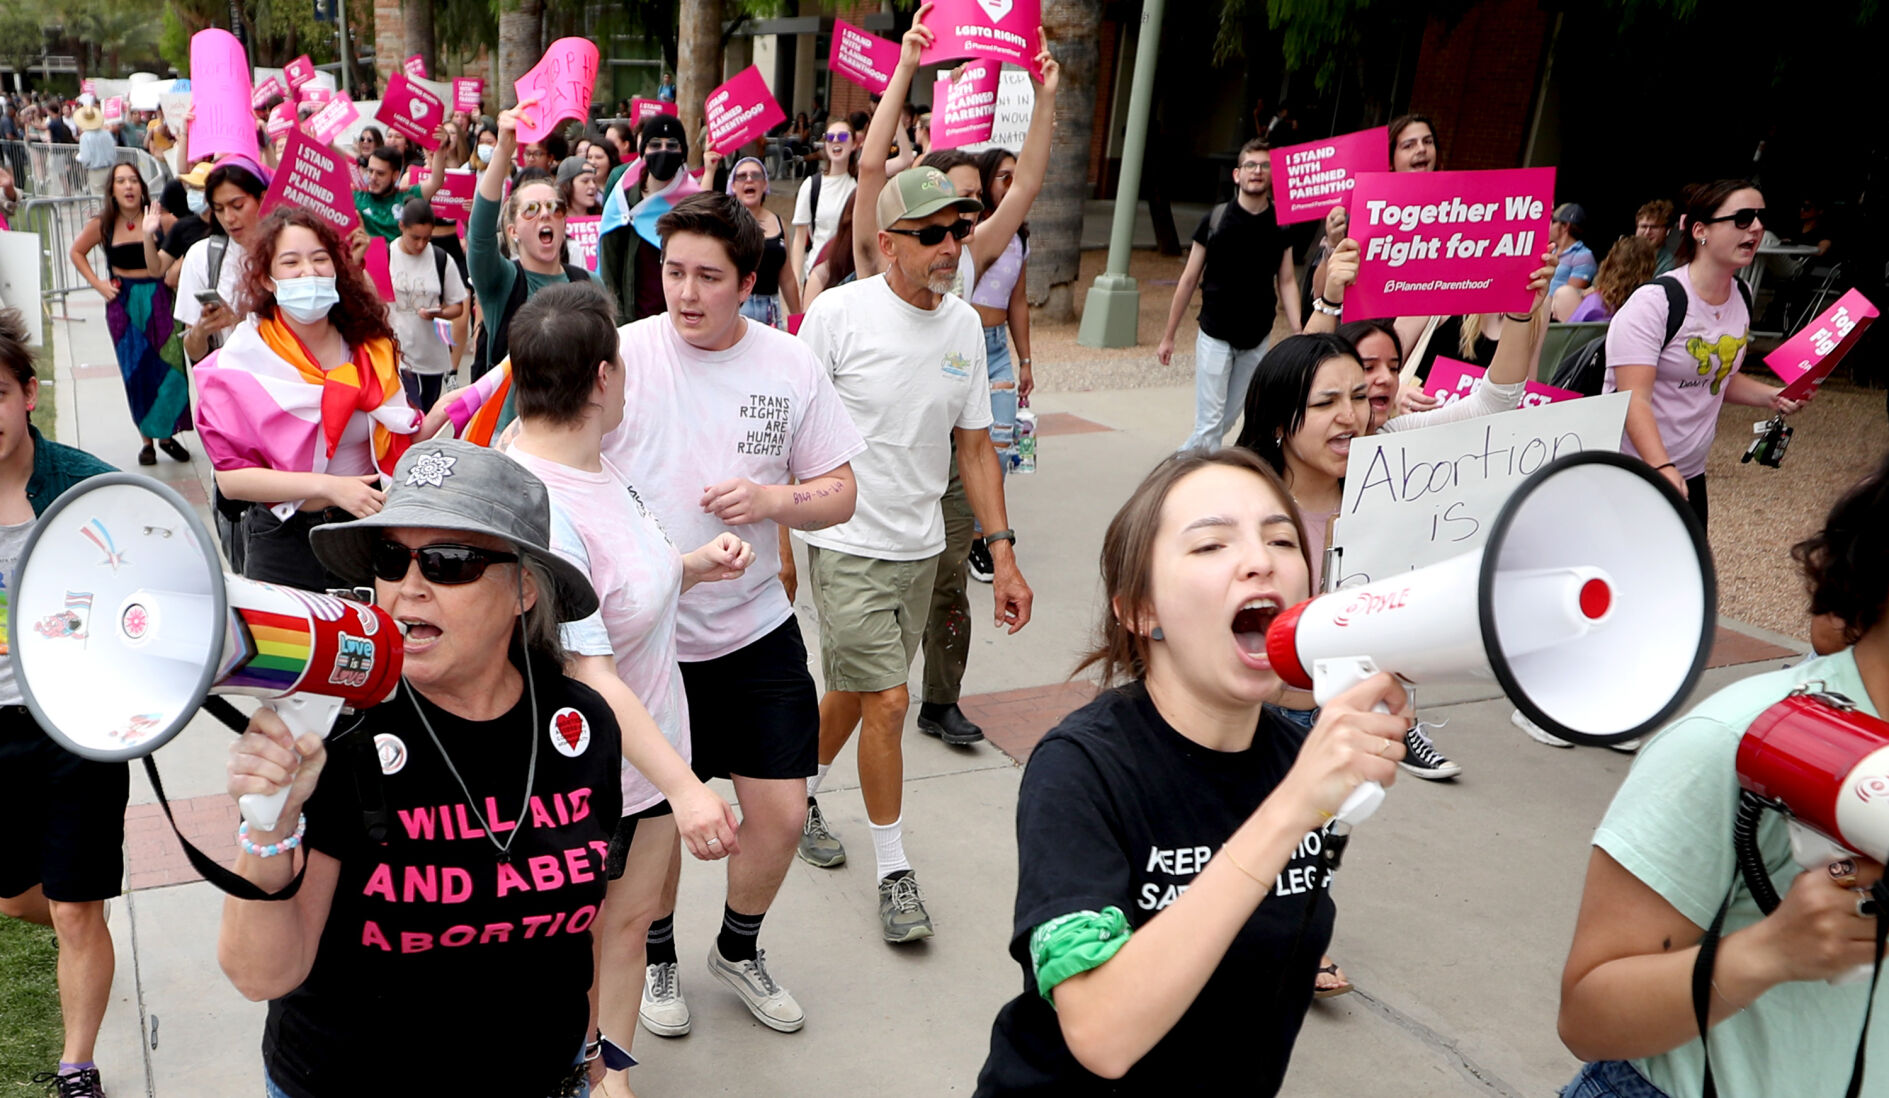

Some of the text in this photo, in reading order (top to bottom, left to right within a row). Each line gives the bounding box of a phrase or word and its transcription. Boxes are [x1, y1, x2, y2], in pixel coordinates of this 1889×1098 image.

[842, 36, 862, 52] WITH
[847, 30, 873, 49] STAND
[955, 25, 1027, 49] LGBTQ RIGHTS
[838, 51, 888, 82] PARENTHOOD
[840, 44, 874, 67] PLANNED
[945, 91, 994, 114] PLANNED
[298, 143, 335, 173] I STAND
[1286, 146, 1336, 166] I STAND
[295, 157, 321, 182] WITH
[1287, 161, 1321, 177] WITH
[1288, 168, 1347, 189] PLANNED
[288, 171, 335, 204] PLANNED
[1289, 178, 1356, 201] PARENTHO
[282, 185, 350, 227] PARENTHOOD
[1366, 195, 1544, 232] Together We
[1365, 230, 1535, 267] Fight for All
[1394, 279, 1490, 292] Planned Parenthood
[740, 406, 790, 421] RIGHTS
[750, 394, 790, 410] TRANS
[746, 431, 786, 445] HUMAN
[765, 420, 788, 433] ARE
[737, 442, 783, 456] RIGHTS
[1352, 425, 1584, 515] Abortion
[1430, 502, 1480, 542] is
[350, 658, 359, 668] is
[331, 668, 367, 686] Love
[397, 787, 593, 841] WILL AID
[362, 840, 608, 904] AND ABET
[1146, 846, 1212, 876] KEEP
[361, 905, 597, 954] ABORTIO
